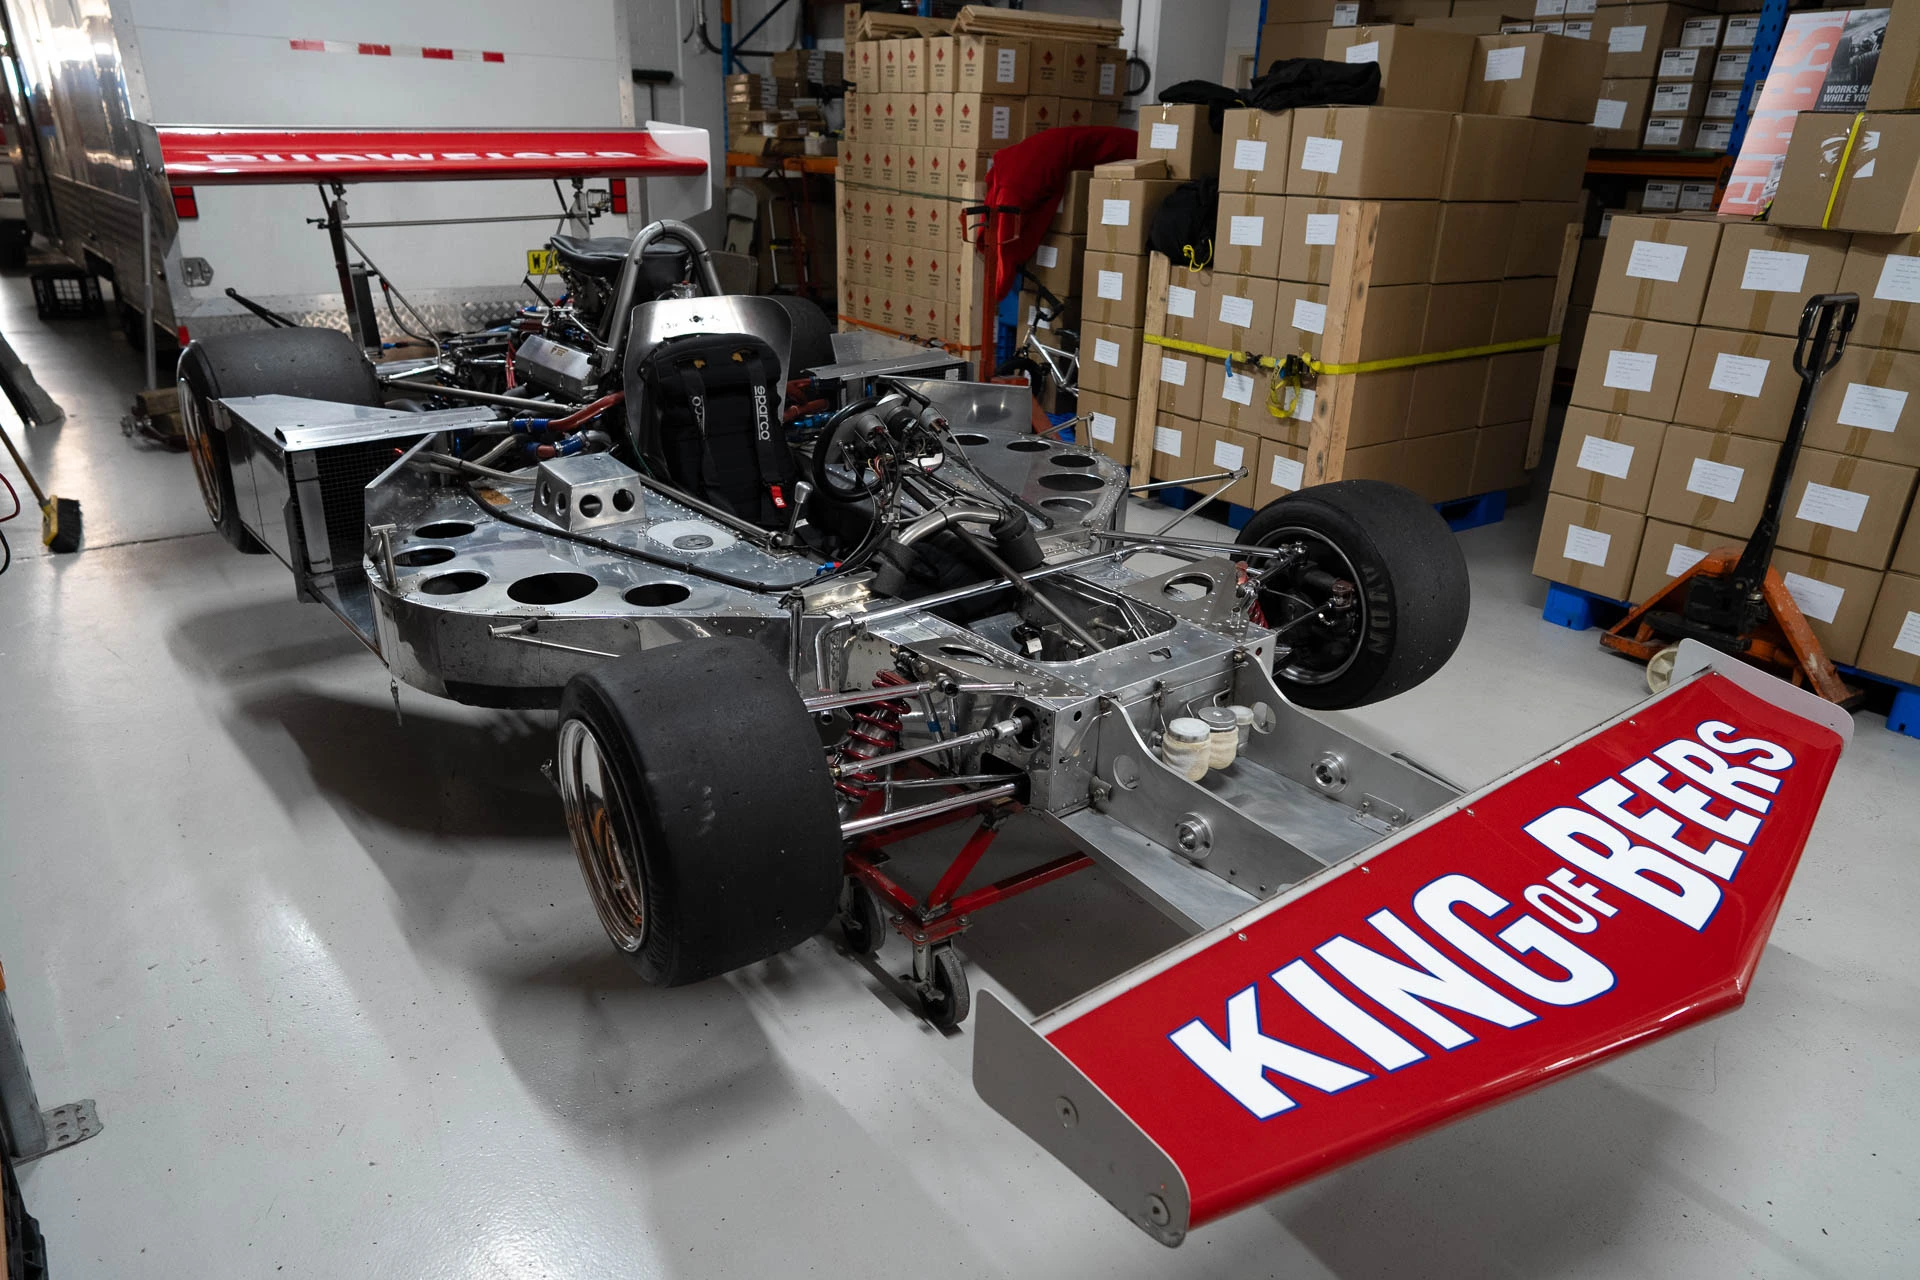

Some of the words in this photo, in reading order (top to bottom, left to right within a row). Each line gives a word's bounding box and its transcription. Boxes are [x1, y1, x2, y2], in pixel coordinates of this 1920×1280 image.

[1823, 94, 1851, 102] WHILE
[1826, 85, 1858, 94] WORKS
[754, 385, 771, 441] sparco
[1362, 565, 1391, 655] AVON
[1522, 719, 1794, 933] BEERS
[1525, 868, 1618, 934] OF
[1167, 873, 1617, 1120] KING
